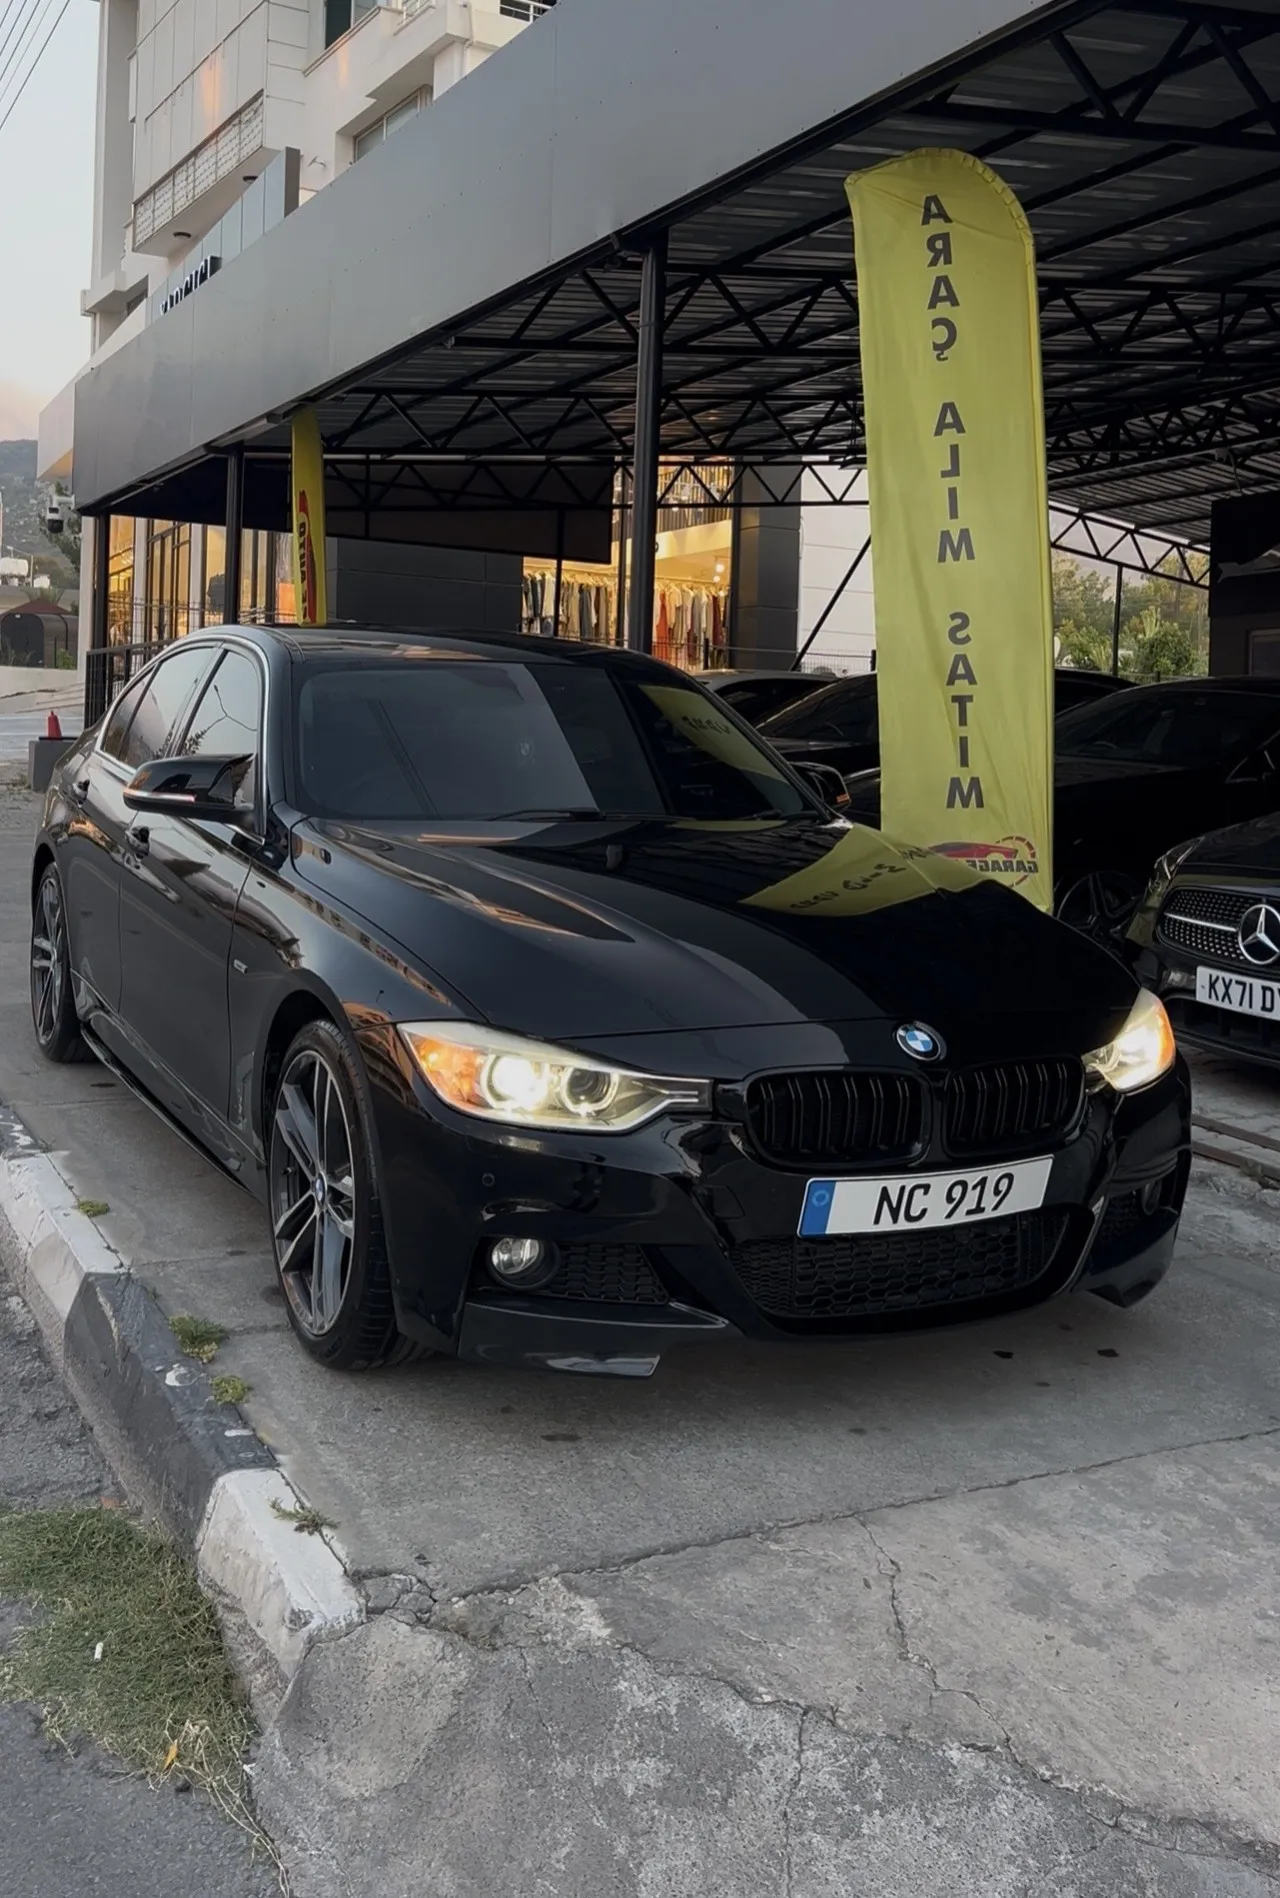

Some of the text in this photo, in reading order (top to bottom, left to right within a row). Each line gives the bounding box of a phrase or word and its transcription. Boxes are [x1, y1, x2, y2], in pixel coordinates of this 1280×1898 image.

[1208, 973, 1280, 1013] KX71 D
[873, 1172, 1015, 1226] NC 919
